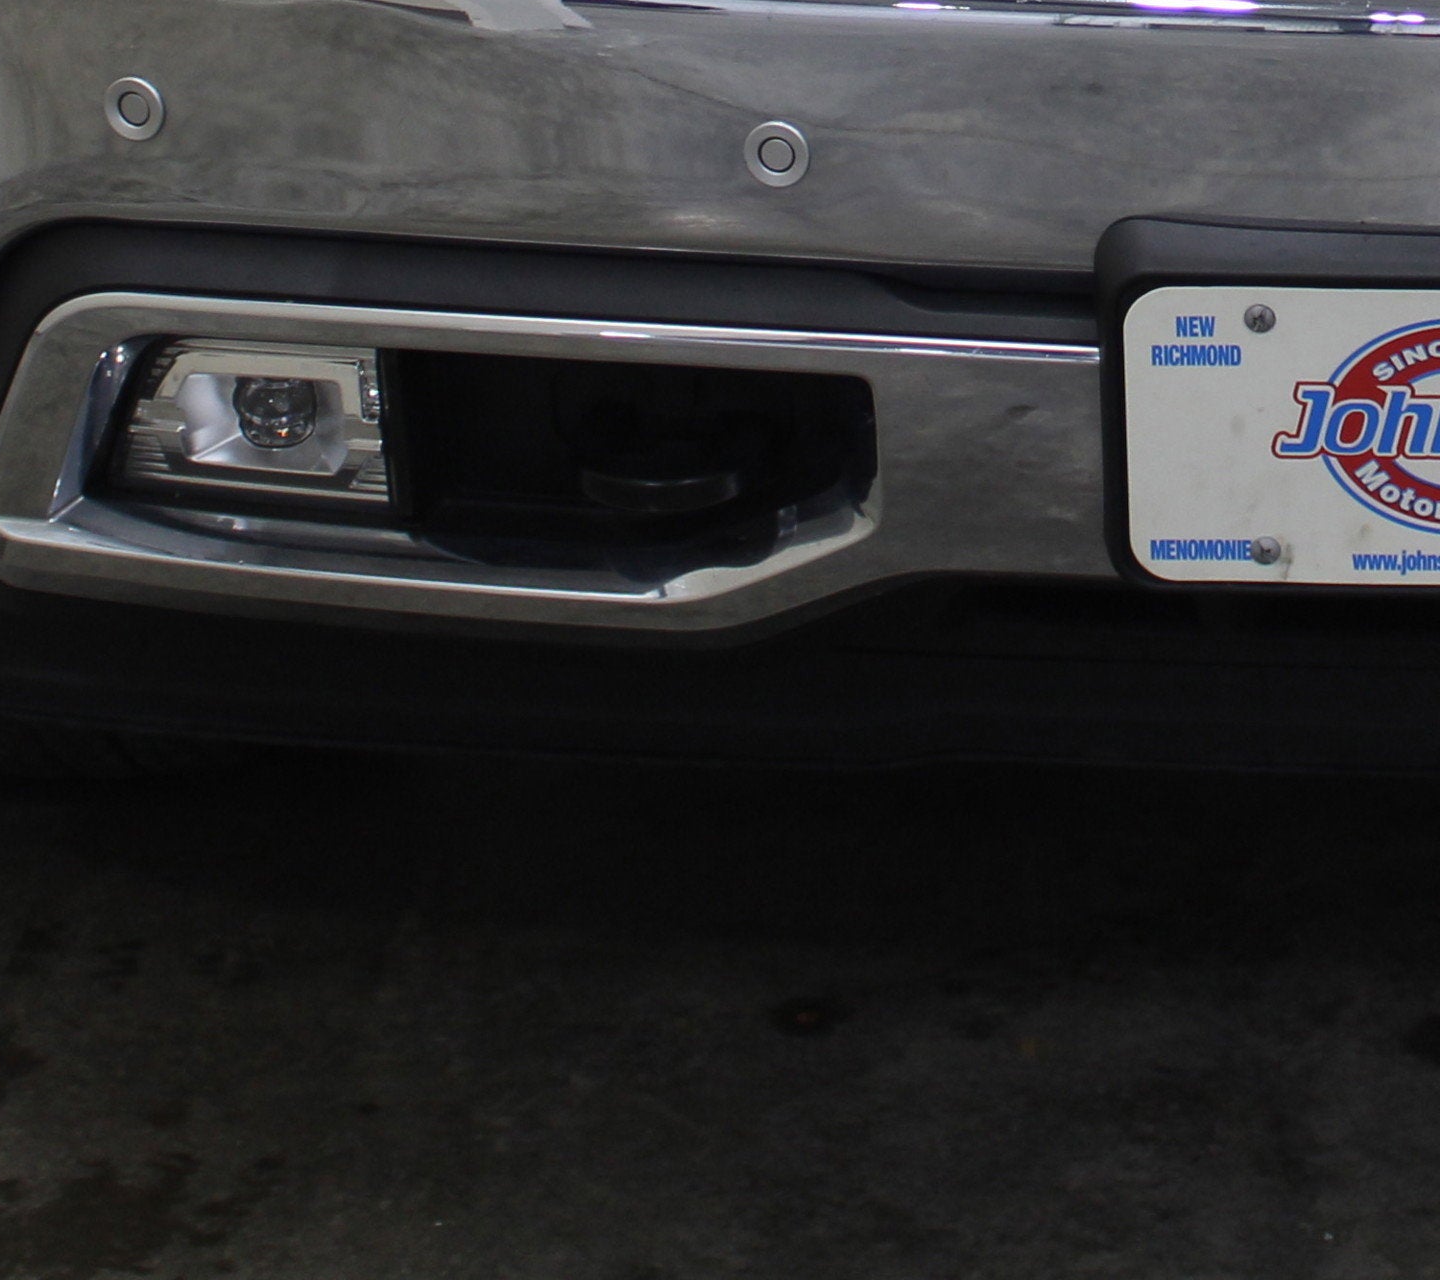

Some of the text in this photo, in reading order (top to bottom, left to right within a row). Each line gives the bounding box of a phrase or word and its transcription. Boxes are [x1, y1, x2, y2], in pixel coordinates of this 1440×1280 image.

[1176, 316, 1215, 337] NEW
[1151, 345, 1242, 366] RICHMOND
[1150, 540, 1252, 561] MENOMONIE
